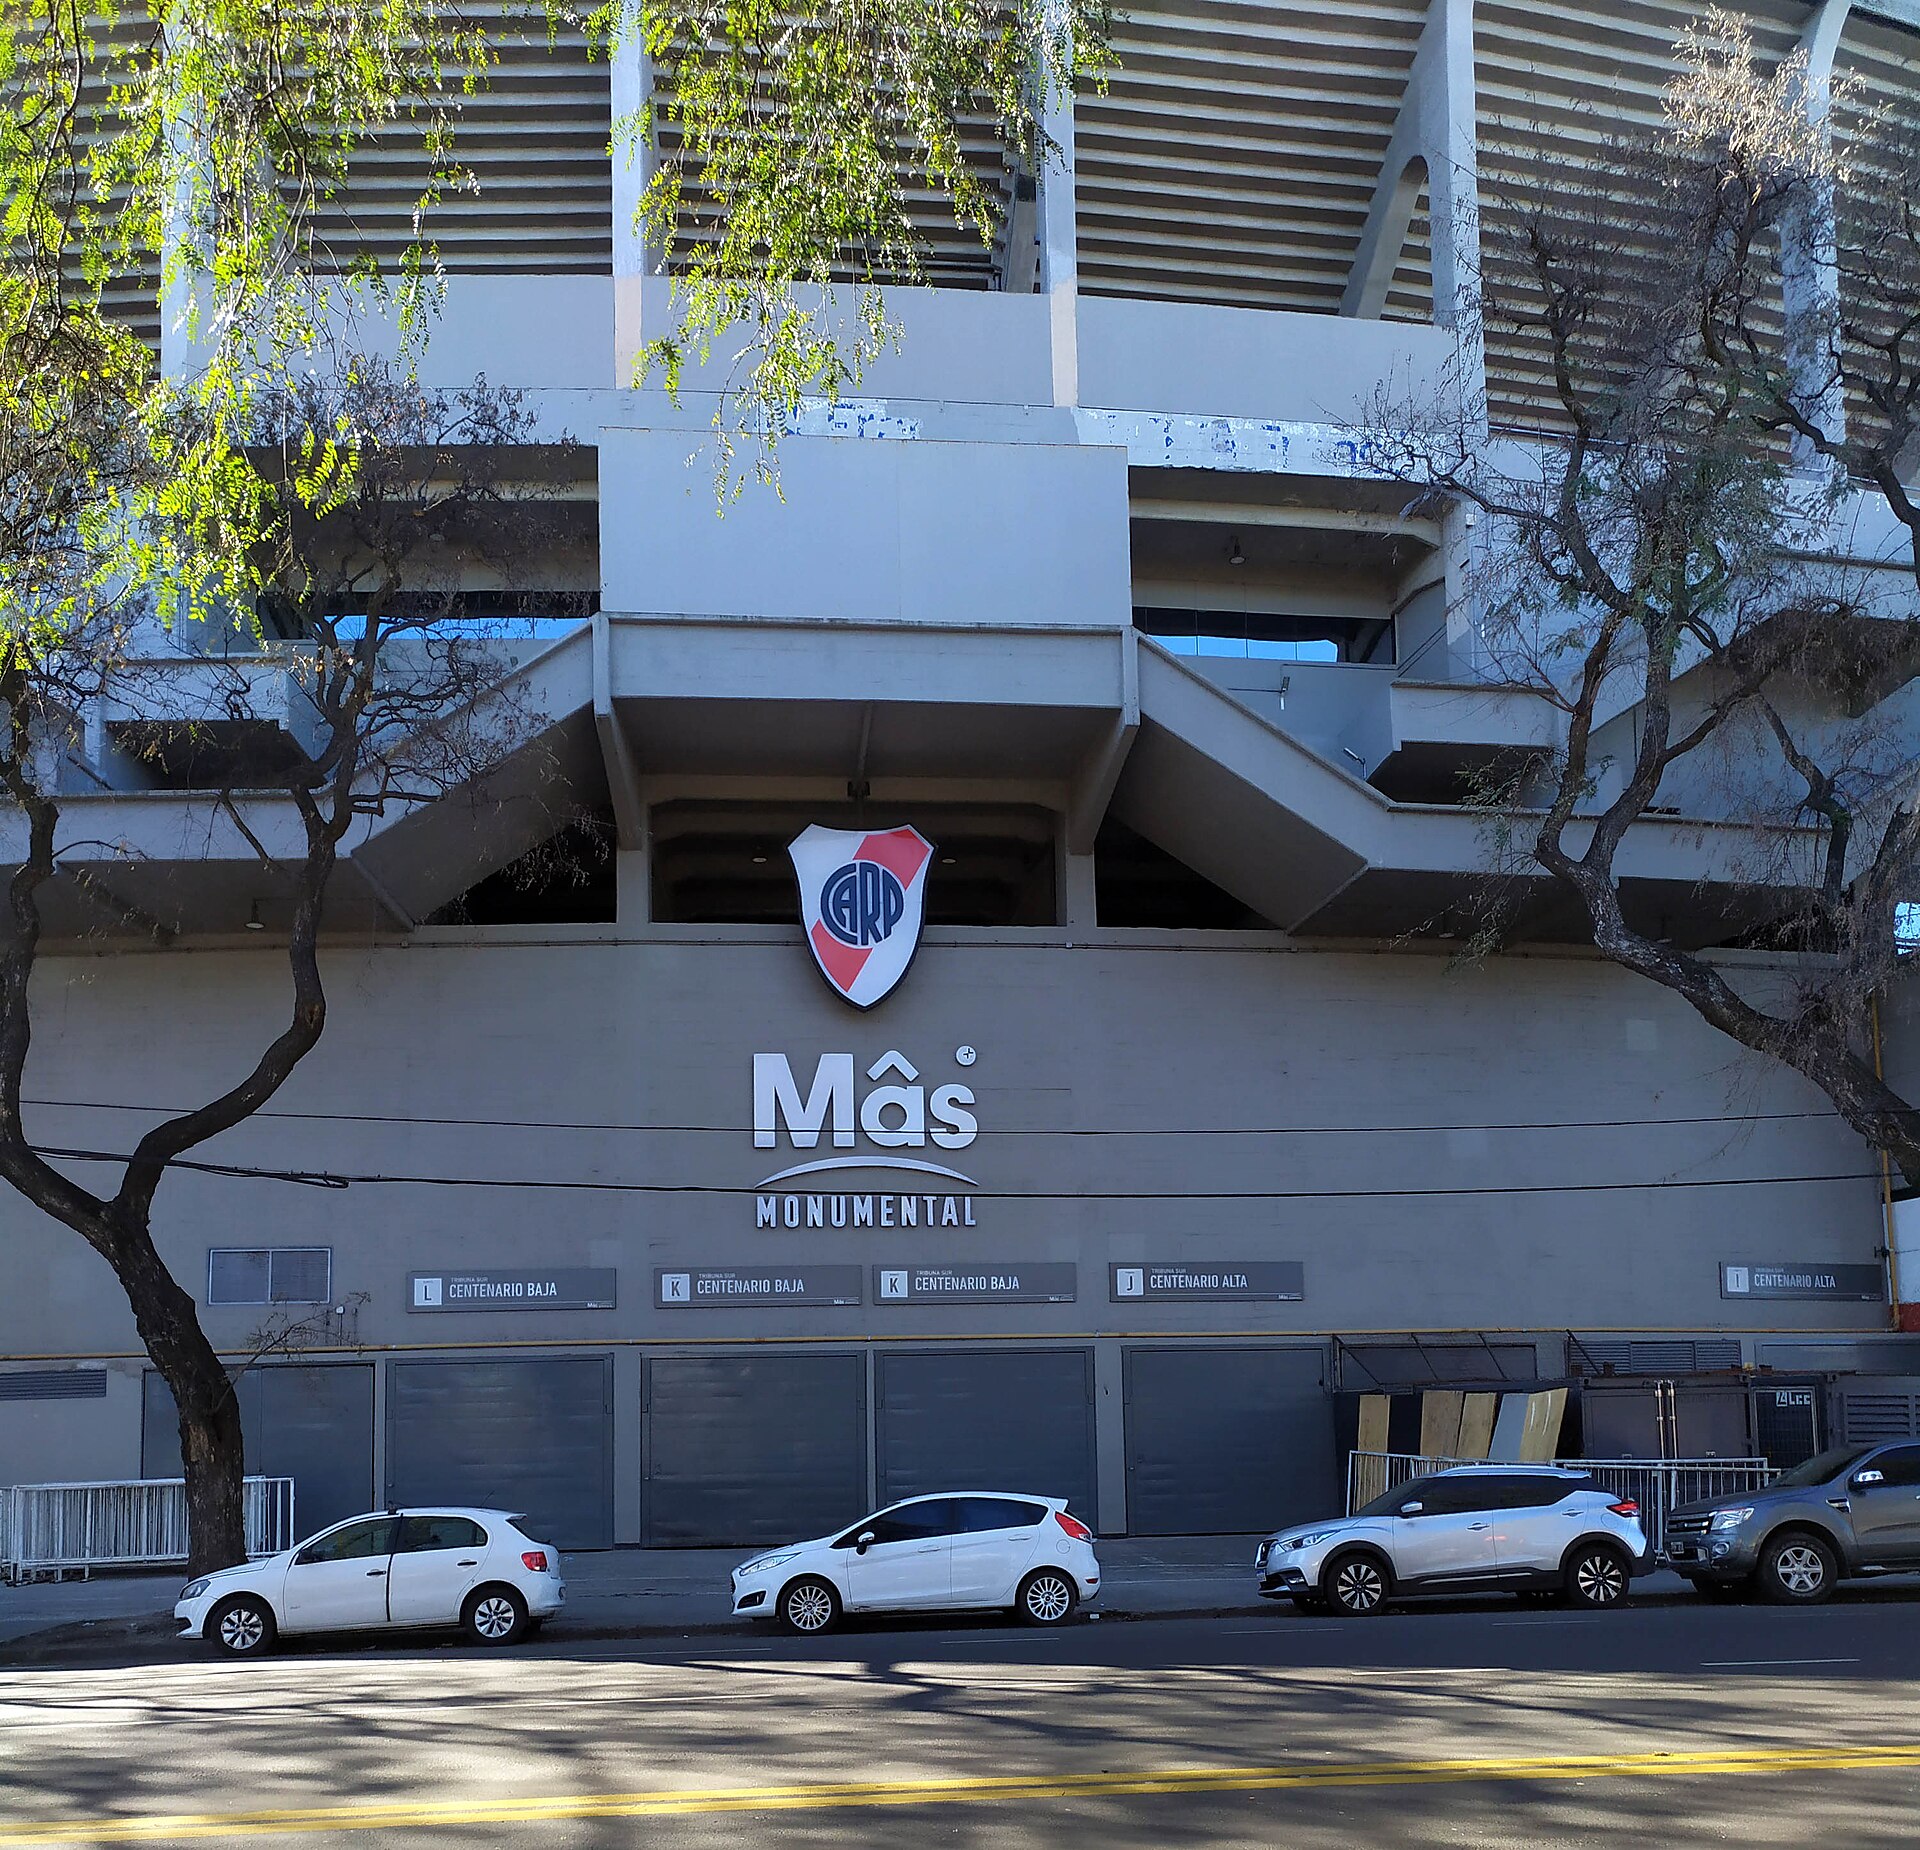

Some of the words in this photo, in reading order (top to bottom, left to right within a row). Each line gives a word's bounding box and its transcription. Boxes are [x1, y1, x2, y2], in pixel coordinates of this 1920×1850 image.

[821, 862, 904, 946] CARP
[753, 1049, 979, 1149] Mâs
[756, 1195, 977, 1229] MONUMENTAL
[671, 1280, 681, 1297] K
[697, 1279, 770, 1294] CENTENARIO
[775, 1279, 804, 1293] BAJA
[889, 1277, 898, 1293] K
[915, 1276, 986, 1291] CENTENARIO
[991, 1276, 1020, 1290] BAJA
[1126, 1275, 1134, 1291] J
[1150, 1274, 1218, 1289] CENTENARIO
[1222, 1274, 1248, 1288] ALTA
[1754, 1274, 1812, 1288] CENTENARIO
[1814, 1275, 1836, 1288] ALTA
[423, 1285, 432, 1301] L
[449, 1283, 523, 1298] CENTENARIO
[527, 1282, 557, 1297] BAJA
